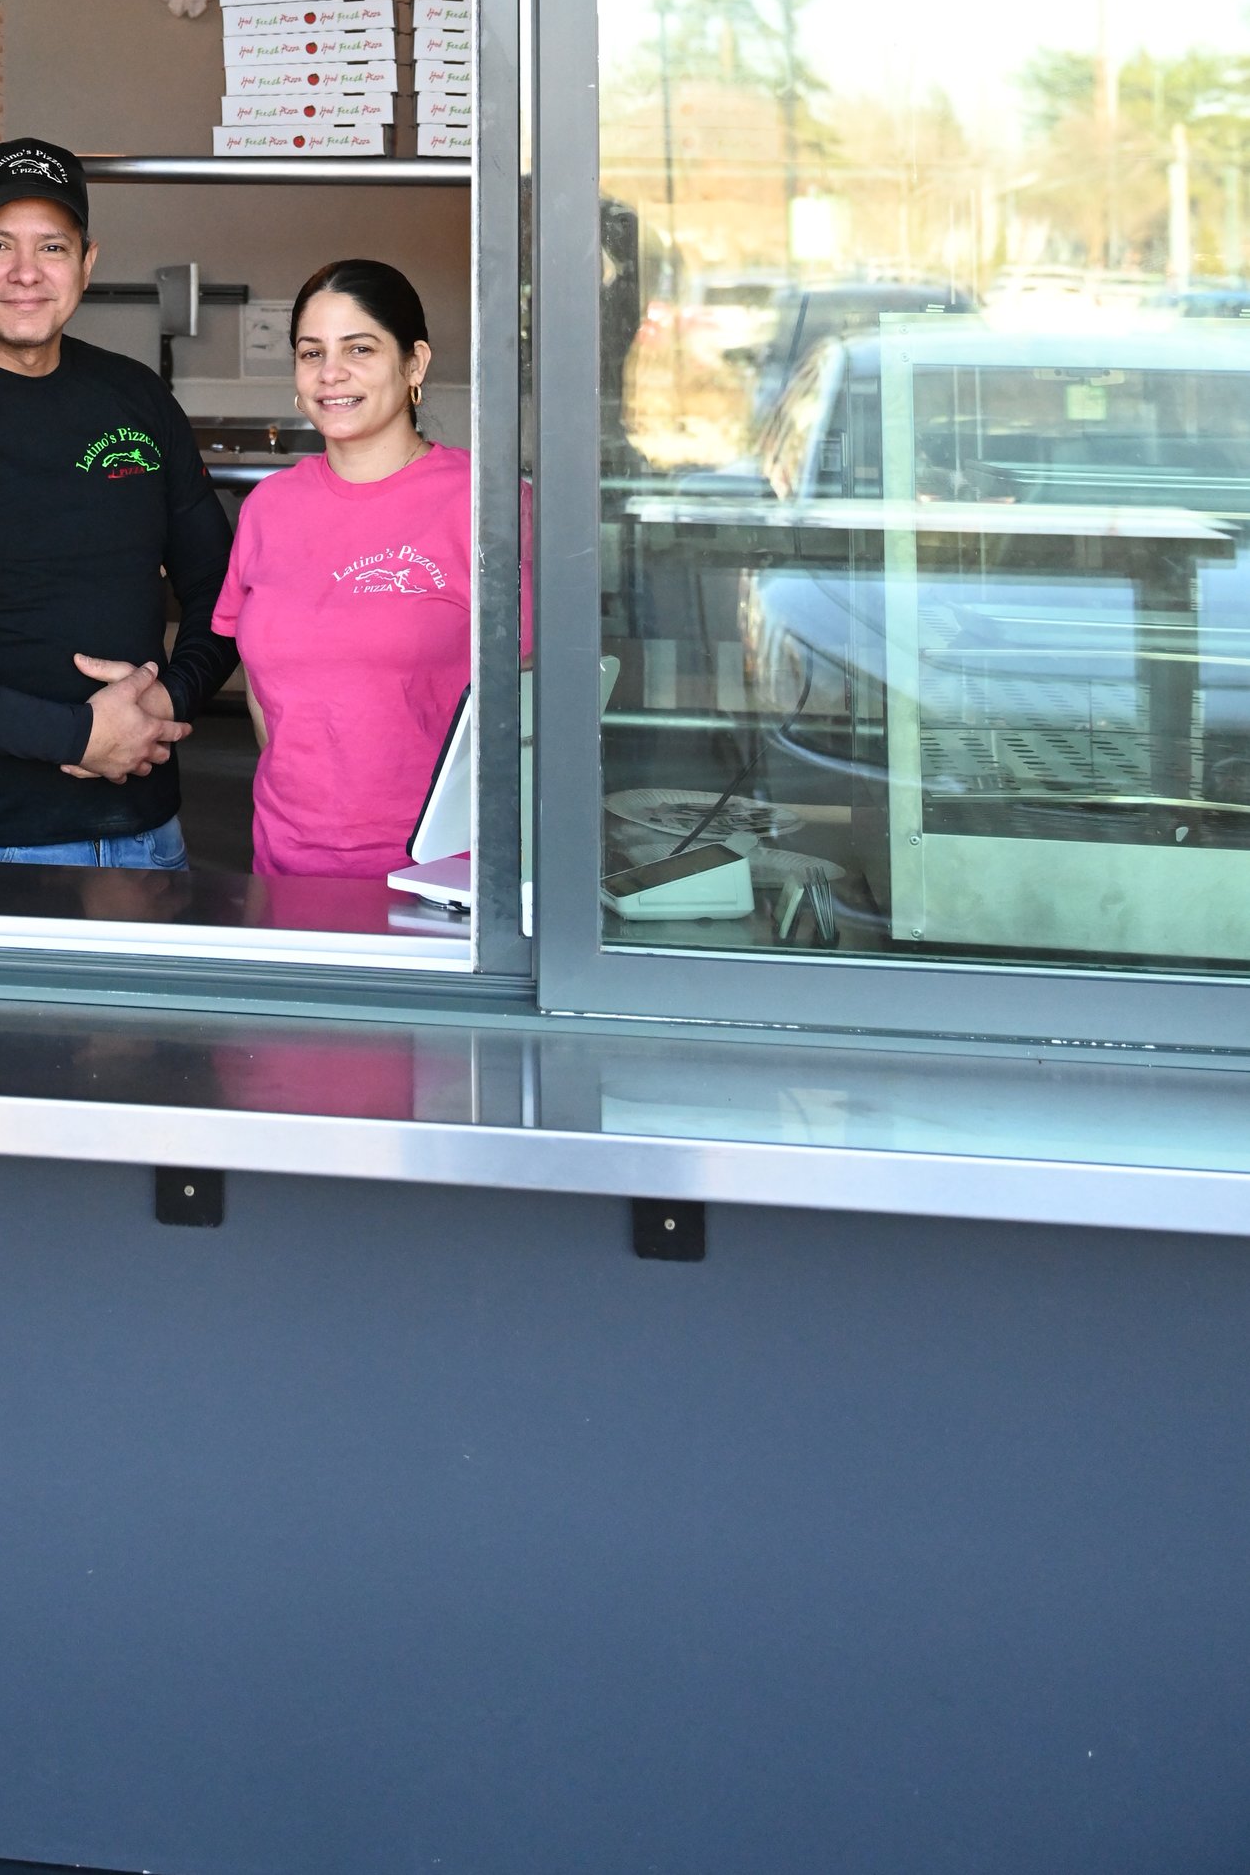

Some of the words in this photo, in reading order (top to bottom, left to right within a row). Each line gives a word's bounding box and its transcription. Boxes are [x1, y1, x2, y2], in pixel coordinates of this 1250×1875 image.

[280, 14, 298, 25] Pizza
[362, 9, 381, 20] Pizza
[269, 137, 287, 146] Pizza
[351, 136, 370, 146] Pizza
[19, 168, 43, 176] PIZZA
[75, 432, 118, 472] Latino's
[332, 547, 395, 582] Latino's
[397, 545, 447, 589] Pizzeria
[364, 584, 393, 593] PIZZA
